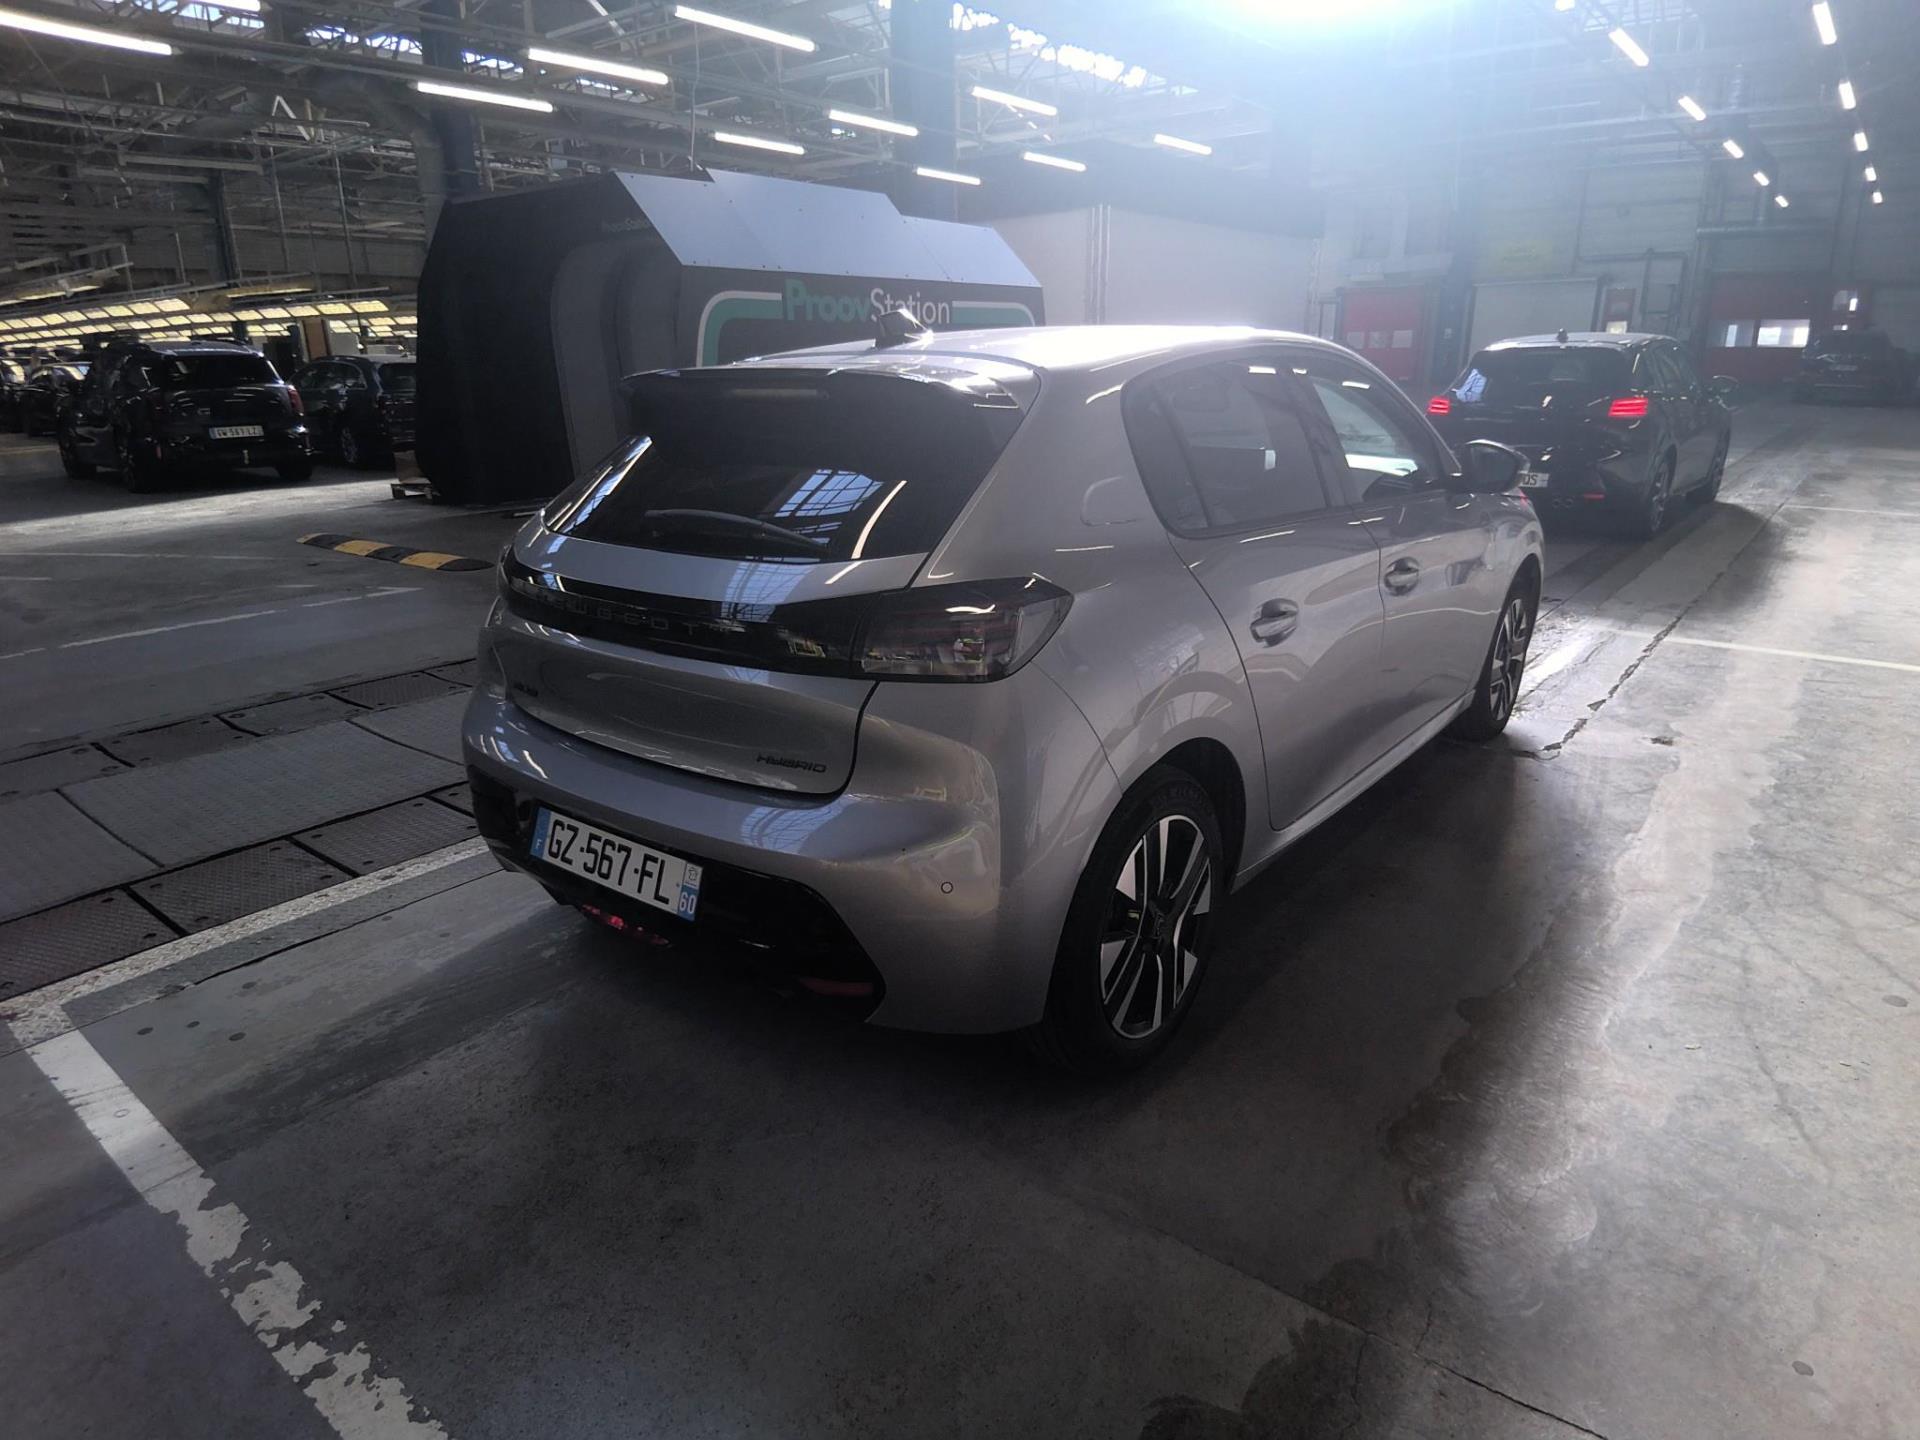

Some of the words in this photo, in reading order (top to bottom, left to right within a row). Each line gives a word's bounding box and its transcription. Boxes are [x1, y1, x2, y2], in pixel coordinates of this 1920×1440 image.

[756, 753, 827, 773] HYBRID
[547, 819, 670, 905] GZ-567-FL
[678, 891, 697, 914] 60
